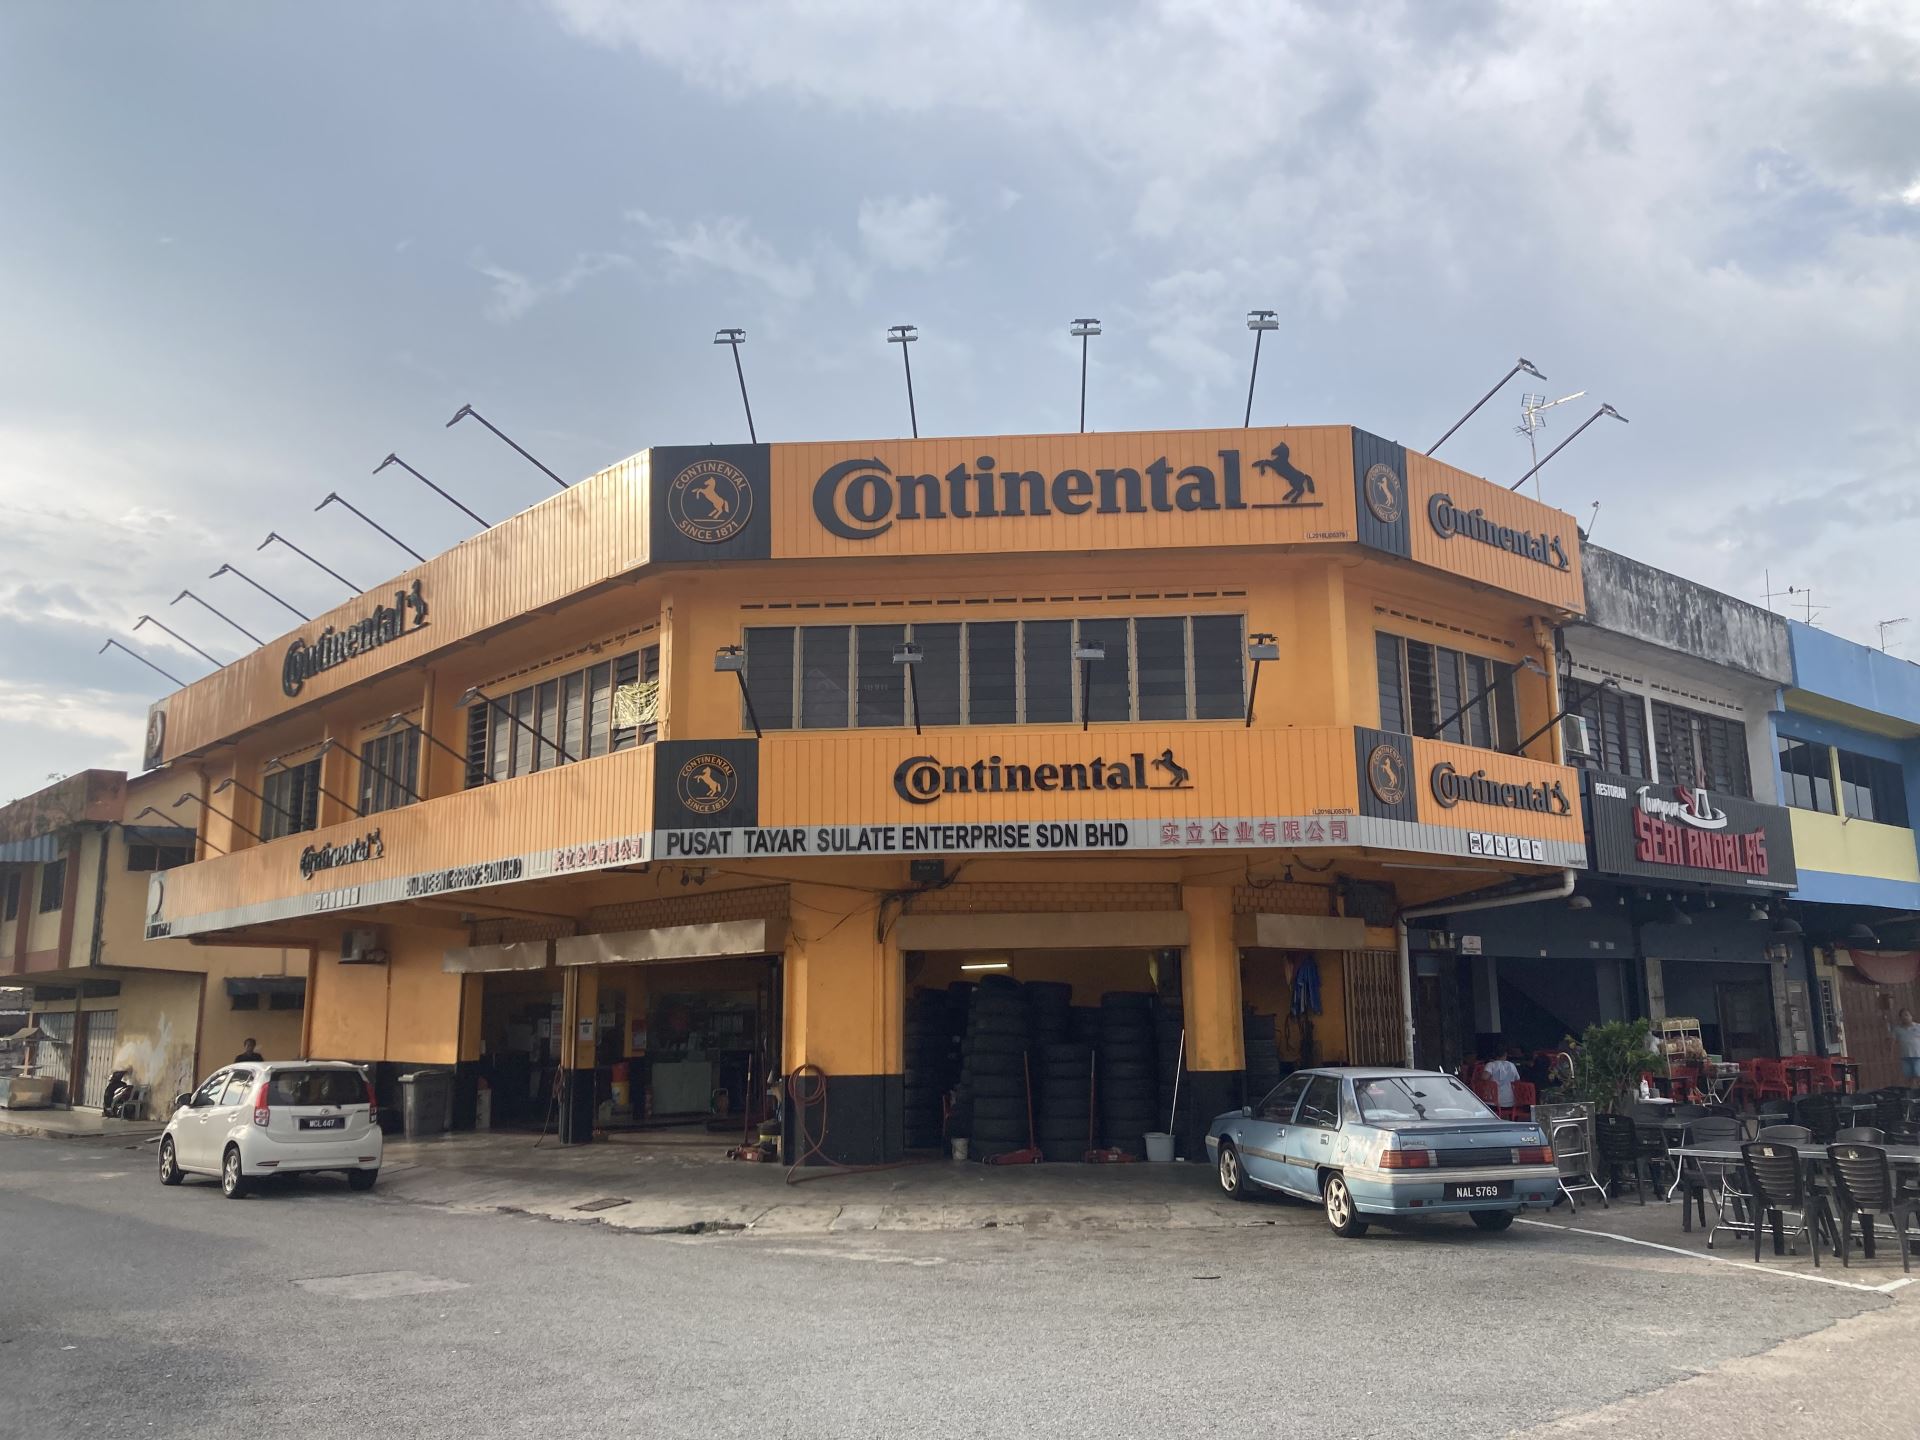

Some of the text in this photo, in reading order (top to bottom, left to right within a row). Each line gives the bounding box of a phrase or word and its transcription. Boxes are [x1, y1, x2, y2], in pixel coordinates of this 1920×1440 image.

[675, 462, 747, 491] CONTINENTAL
[812, 449, 1248, 540] Continental
[679, 520, 739, 540] SINCE 1871
[1428, 492, 1552, 566] Continental
[282, 590, 407, 698] Continental
[681, 756, 734, 778] CONTINENTAL
[894, 753, 1149, 804] Continental
[1431, 761, 1553, 814] Continental
[685, 797, 729, 813] SINCE 1871
[667, 823, 1129, 856] PUSAT TAYAR SULATE ENTERPRISE SDN BHD
[1161, 821, 1349, 844] 实立企业有限公司
[1634, 805, 1685, 866] SERI
[435, 863, 483, 892] ENTERPRISE
[1456, 1186, 1498, 1198] NAL 5769
